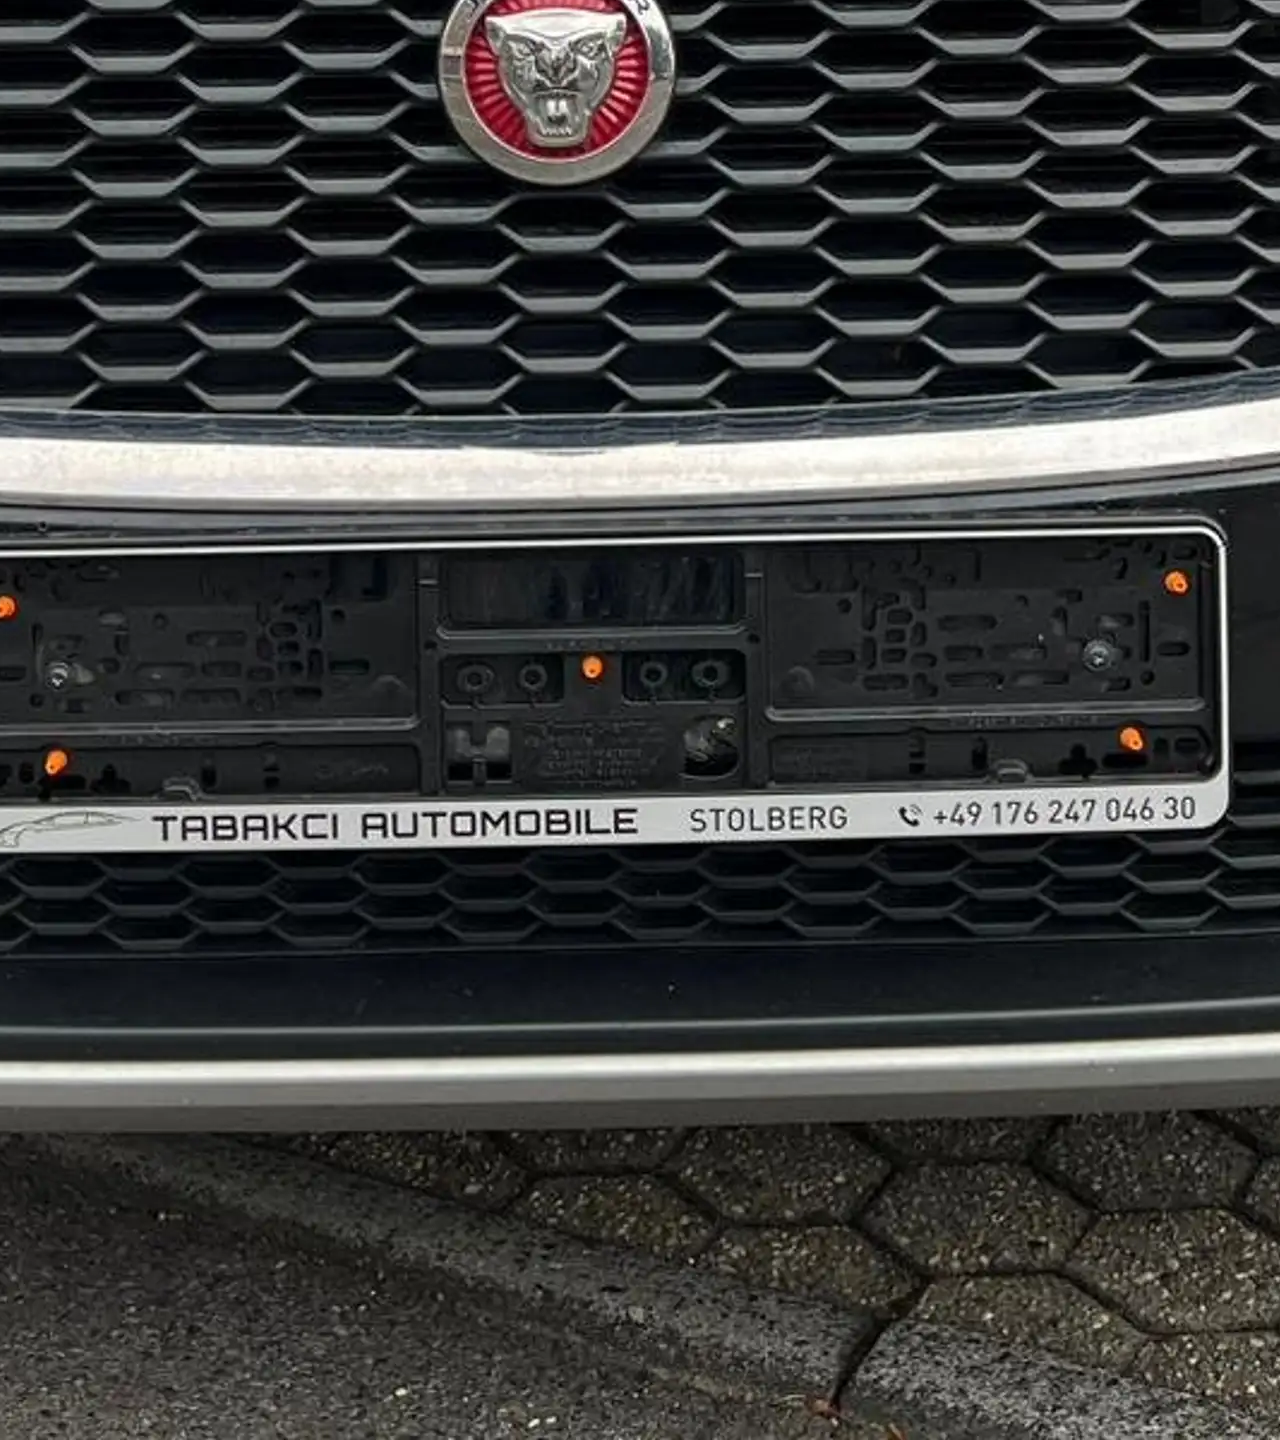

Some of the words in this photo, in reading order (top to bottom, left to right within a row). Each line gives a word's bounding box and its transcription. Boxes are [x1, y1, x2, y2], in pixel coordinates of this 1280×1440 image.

[151, 813, 340, 843] TABAKCI
[360, 807, 640, 840] AUTOMOBILE
[689, 805, 849, 834] STOLBERG
[932, 801, 982, 827] +49
[991, 800, 1039, 825] 176
[1048, 798, 1097, 824] 247
[1105, 796, 1155, 822] 046
[1163, 795, 1197, 821] 30
